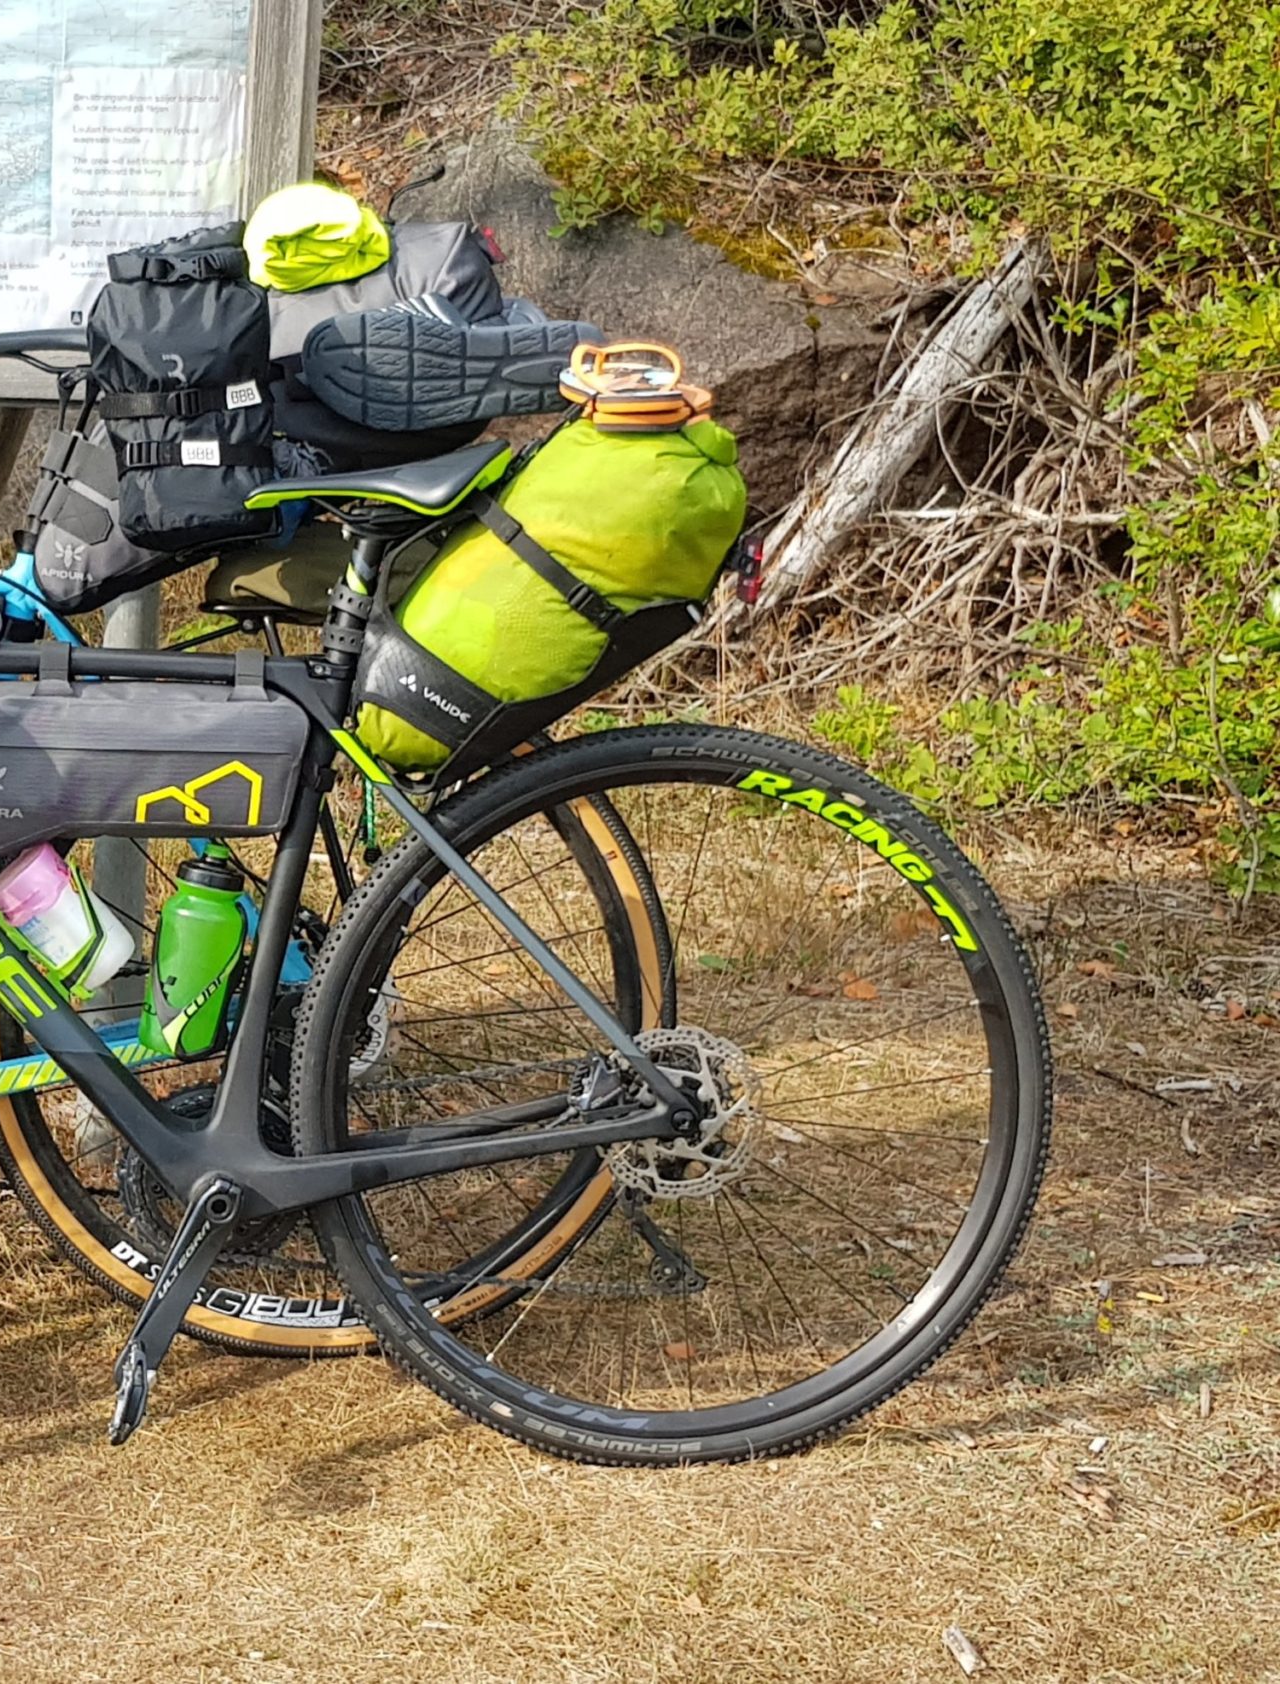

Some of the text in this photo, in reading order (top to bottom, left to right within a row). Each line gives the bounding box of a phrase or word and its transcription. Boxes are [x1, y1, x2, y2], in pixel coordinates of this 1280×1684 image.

[40, 567, 94, 582] APIDURA
[422, 685, 473, 725] VAUDE
[736, 768, 935, 883] RACING
[110, 1240, 149, 1269] DT
[156, 1218, 211, 1300] ULTEGRA
[522, 1417, 703, 1455] SCHWALBE
